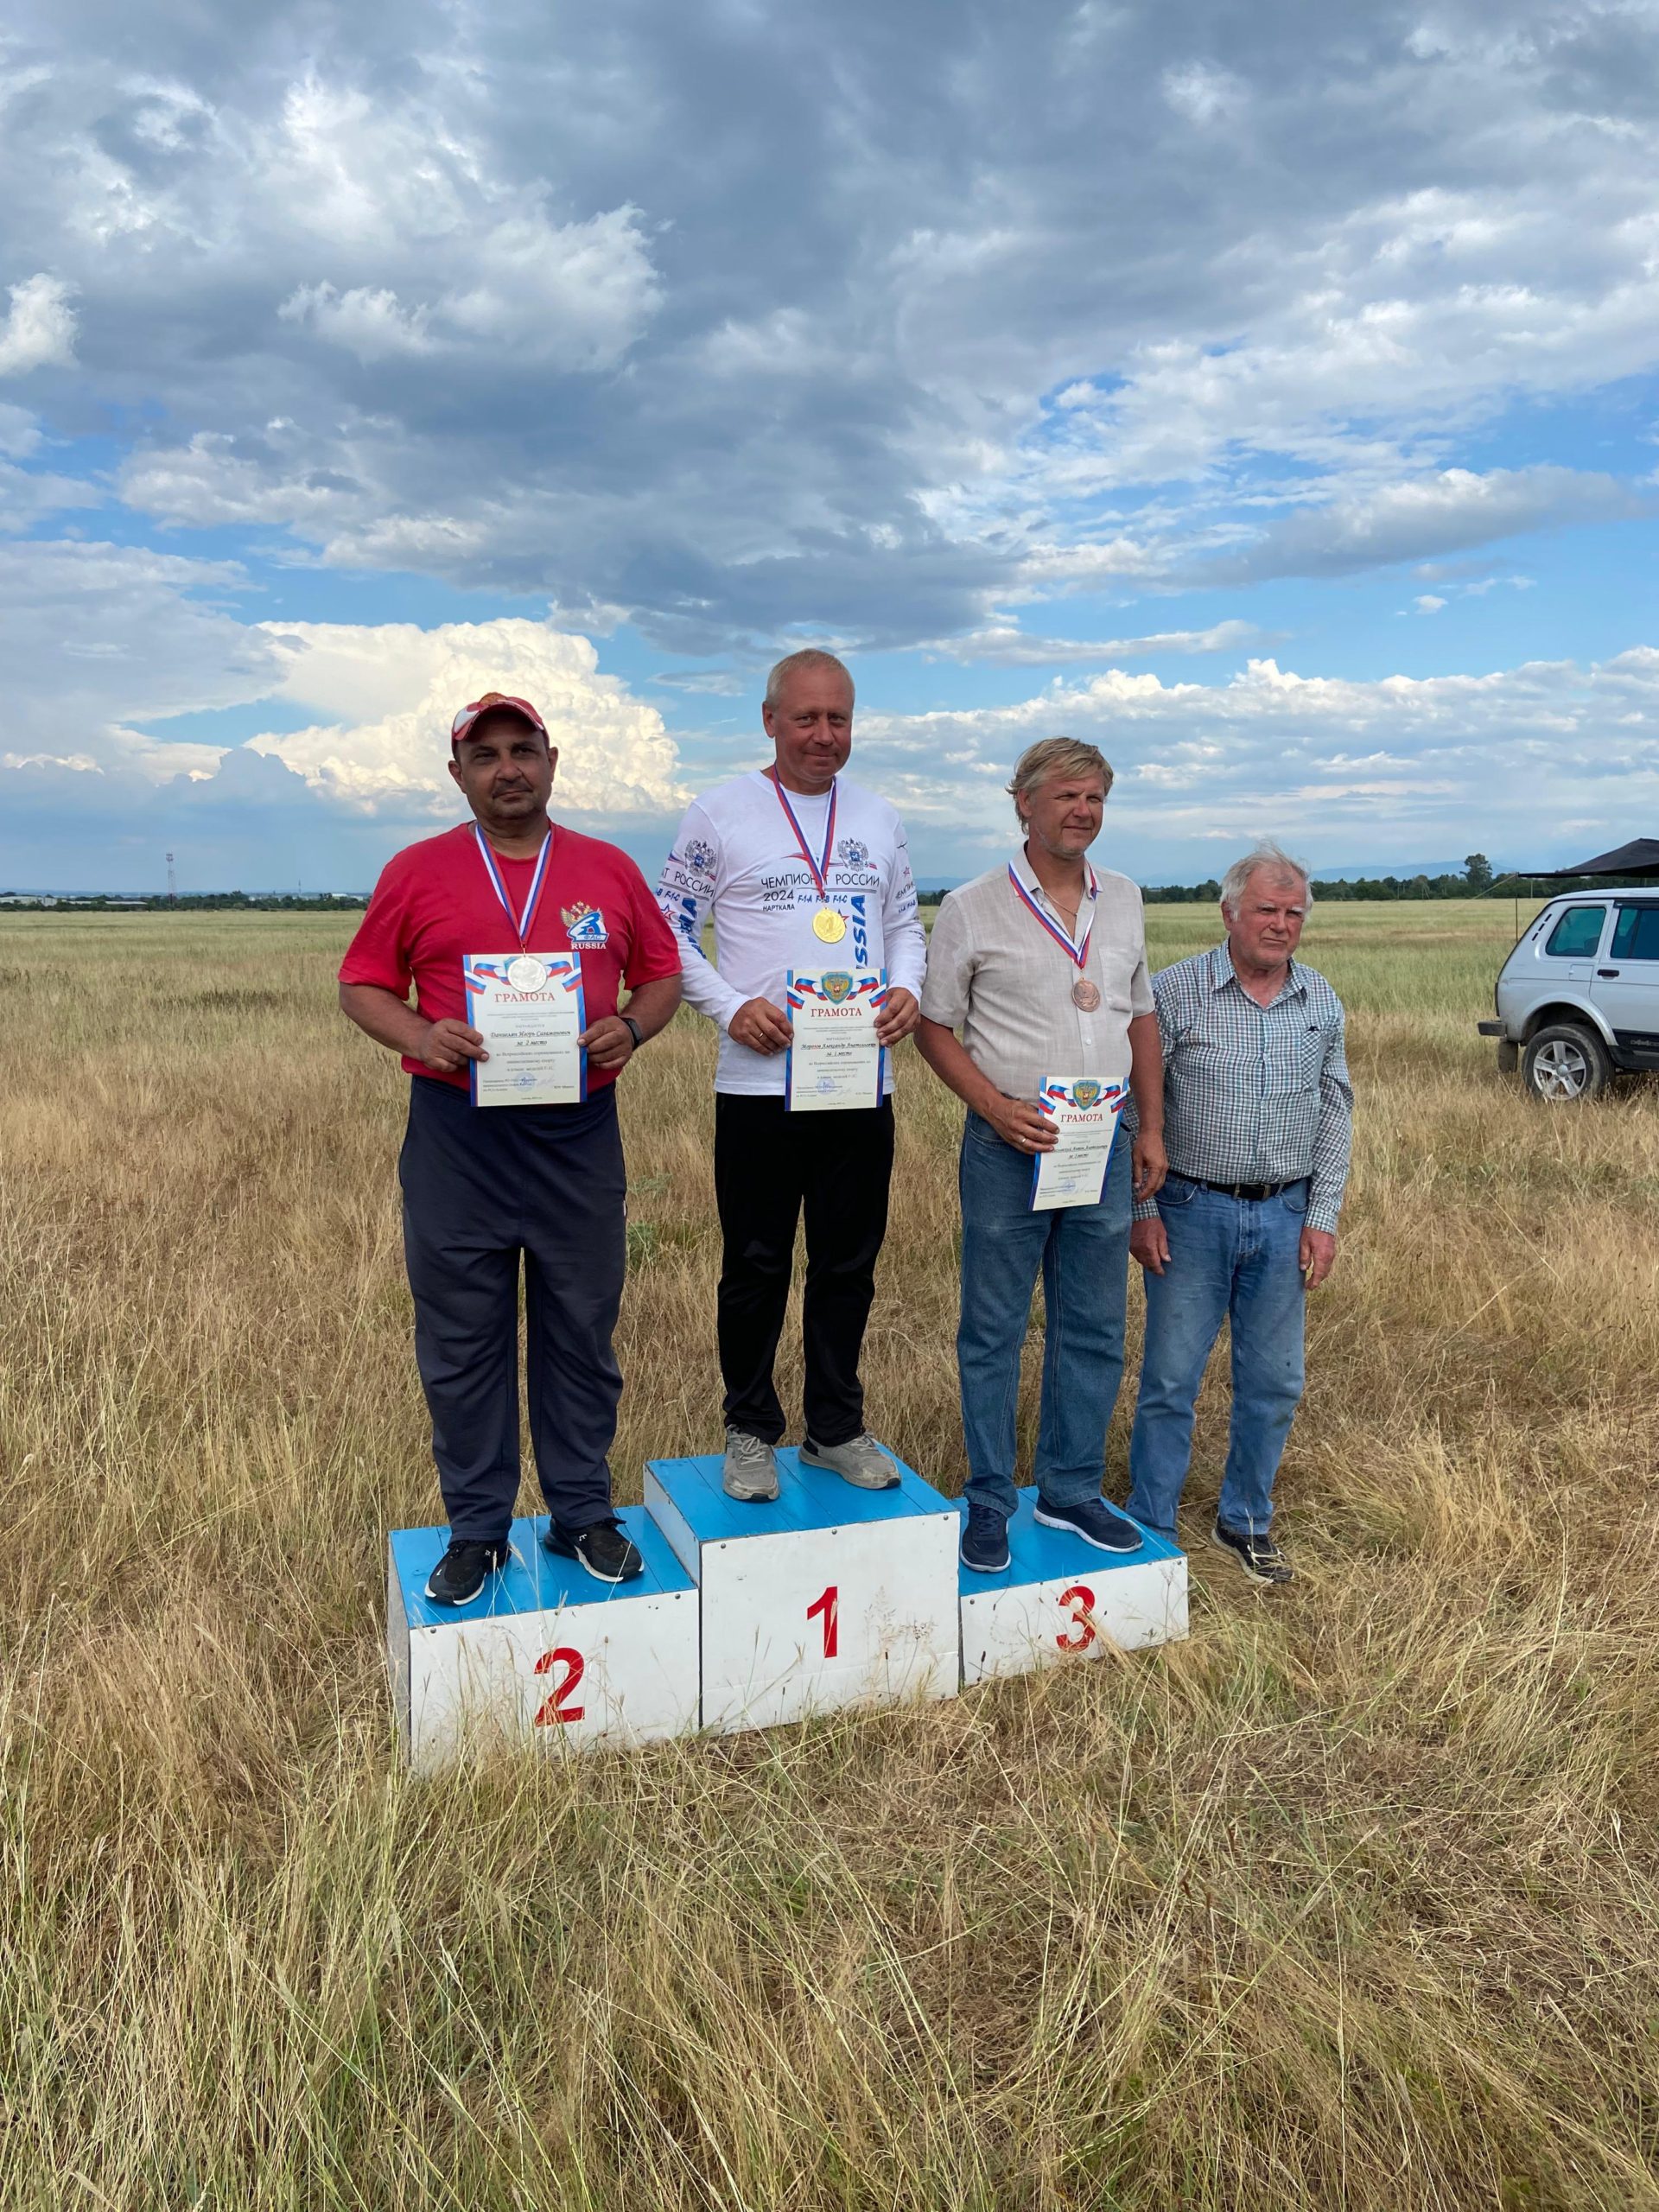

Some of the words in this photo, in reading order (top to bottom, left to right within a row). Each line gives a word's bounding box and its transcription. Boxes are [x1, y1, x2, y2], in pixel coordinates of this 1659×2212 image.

[674, 871, 715, 898] РОССИИ
[760, 873, 829, 889] ЧЕМПИОНТ
[836, 874, 880, 887] РОССИИ
[763, 889, 794, 902] 2024
[763, 904, 795, 912] НАРТКАЛА
[850, 895, 868, 969] SSIA
[494, 992, 556, 1003] ГРАМОТА
[810, 1007, 862, 1018] ГРАМОТА
[1060, 1113, 1103, 1122] ГРАМОТА
[806, 1586, 839, 1658] 1
[1055, 1586, 1096, 1652] 3
[533, 1647, 586, 1727] 2
